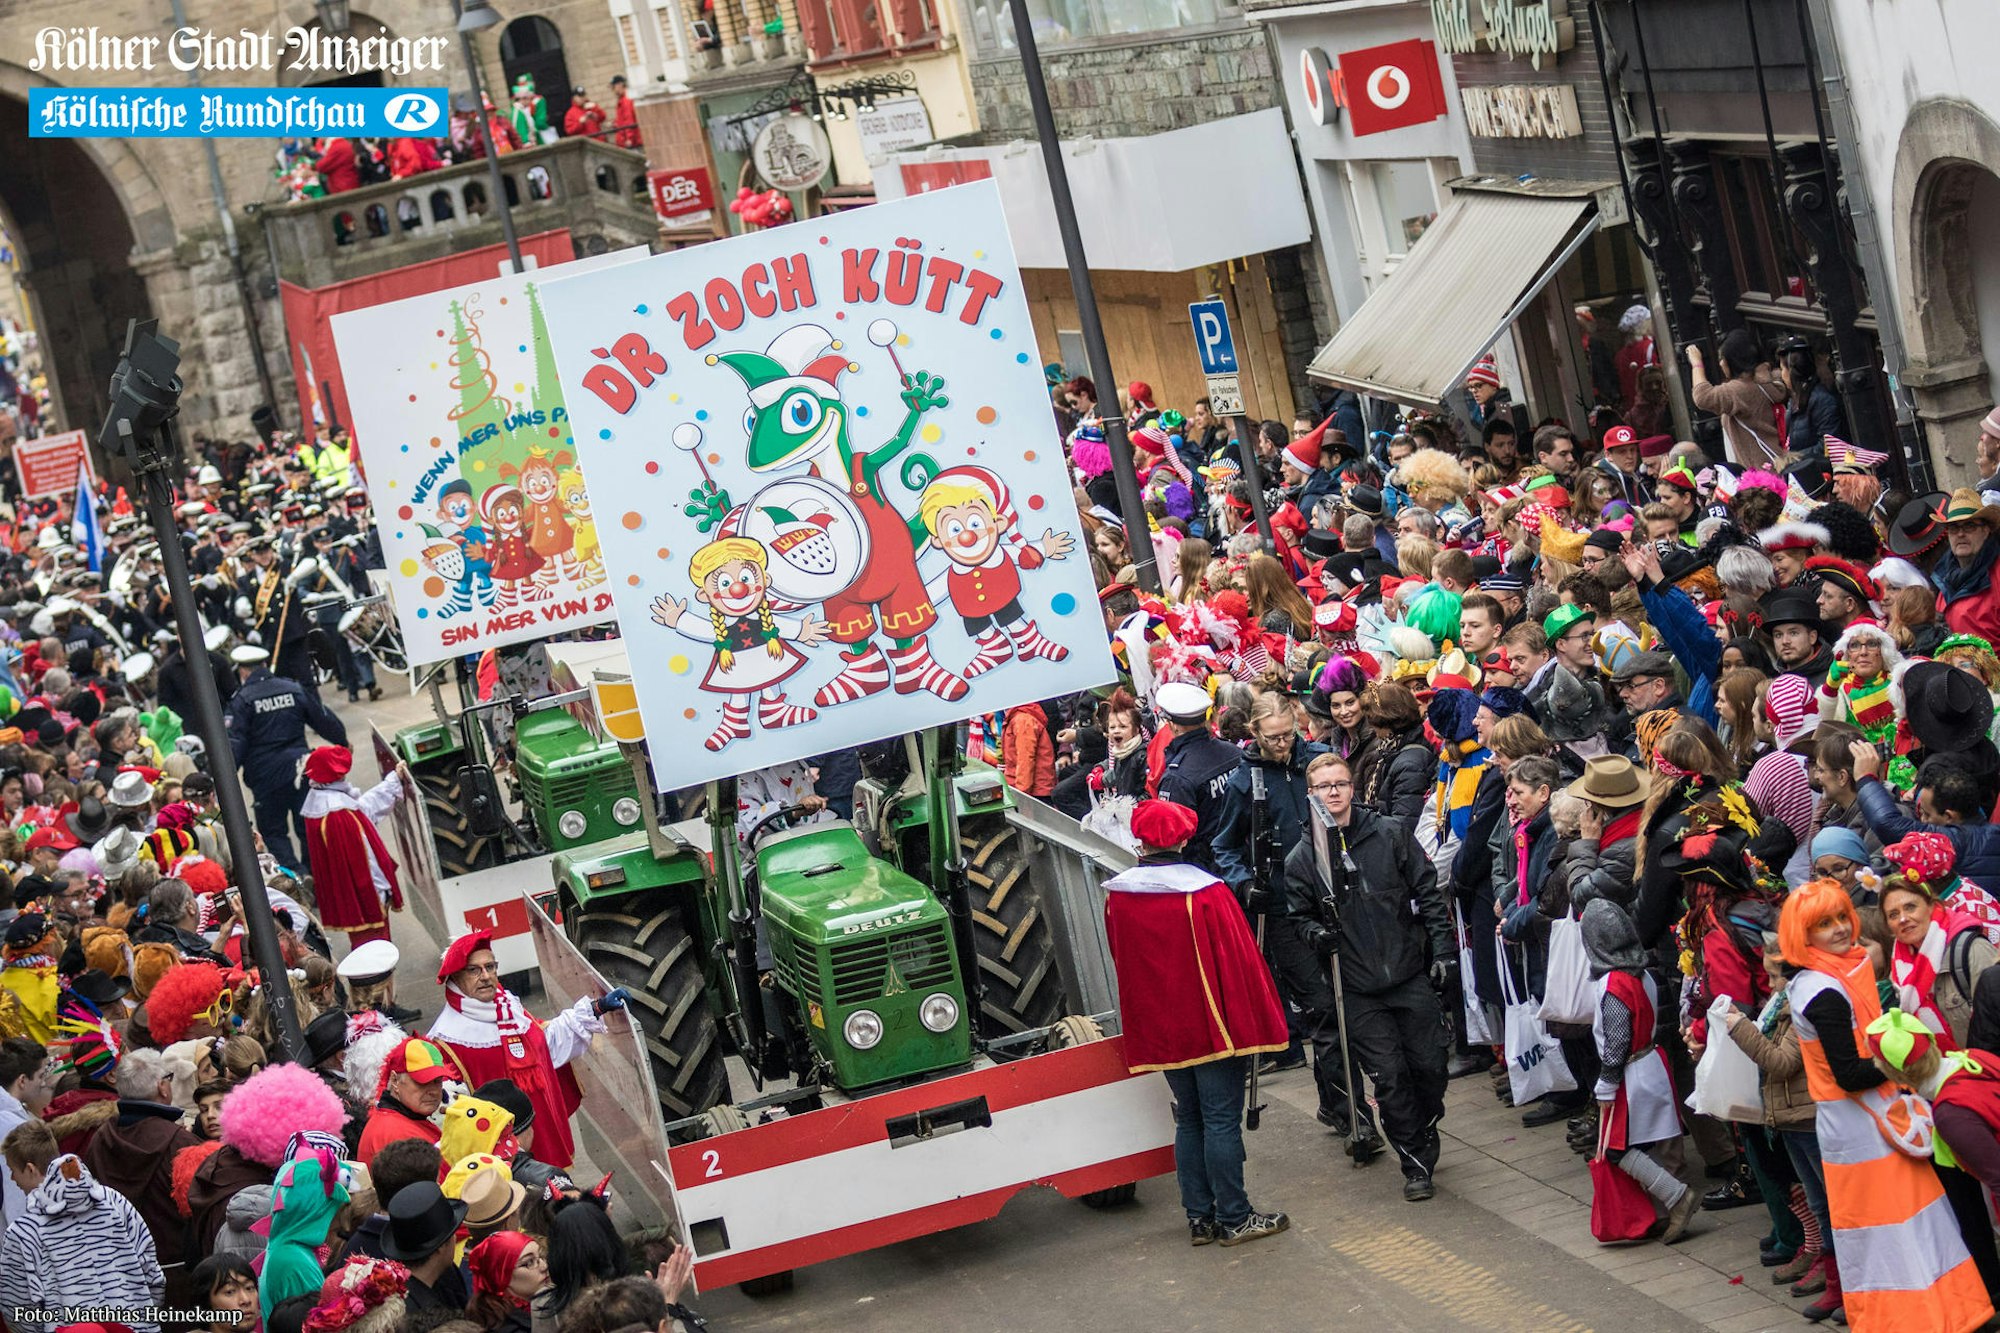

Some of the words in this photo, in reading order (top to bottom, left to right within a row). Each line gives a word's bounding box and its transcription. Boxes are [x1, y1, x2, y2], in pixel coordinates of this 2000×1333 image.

[662, 177, 701, 203] DER
[665, 252, 818, 351] ZOCH
[840, 236, 1004, 326] KÜTT
[1199, 312, 1222, 366] P
[411, 450, 455, 504] WENN
[457, 423, 500, 456] MER
[503, 410, 547, 432] UNS
[1708, 506, 1727, 518] FBI
[441, 622, 479, 646] SIN
[485, 610, 537, 635] MER
[541, 598, 588, 621] VUN
[254, 693, 295, 714] POLIZEI
[486, 907, 499, 928] 1
[843, 910, 922, 935] DEUTZ
[893, 1008, 908, 1031] 2
[702, 1150, 723, 1178] 2
